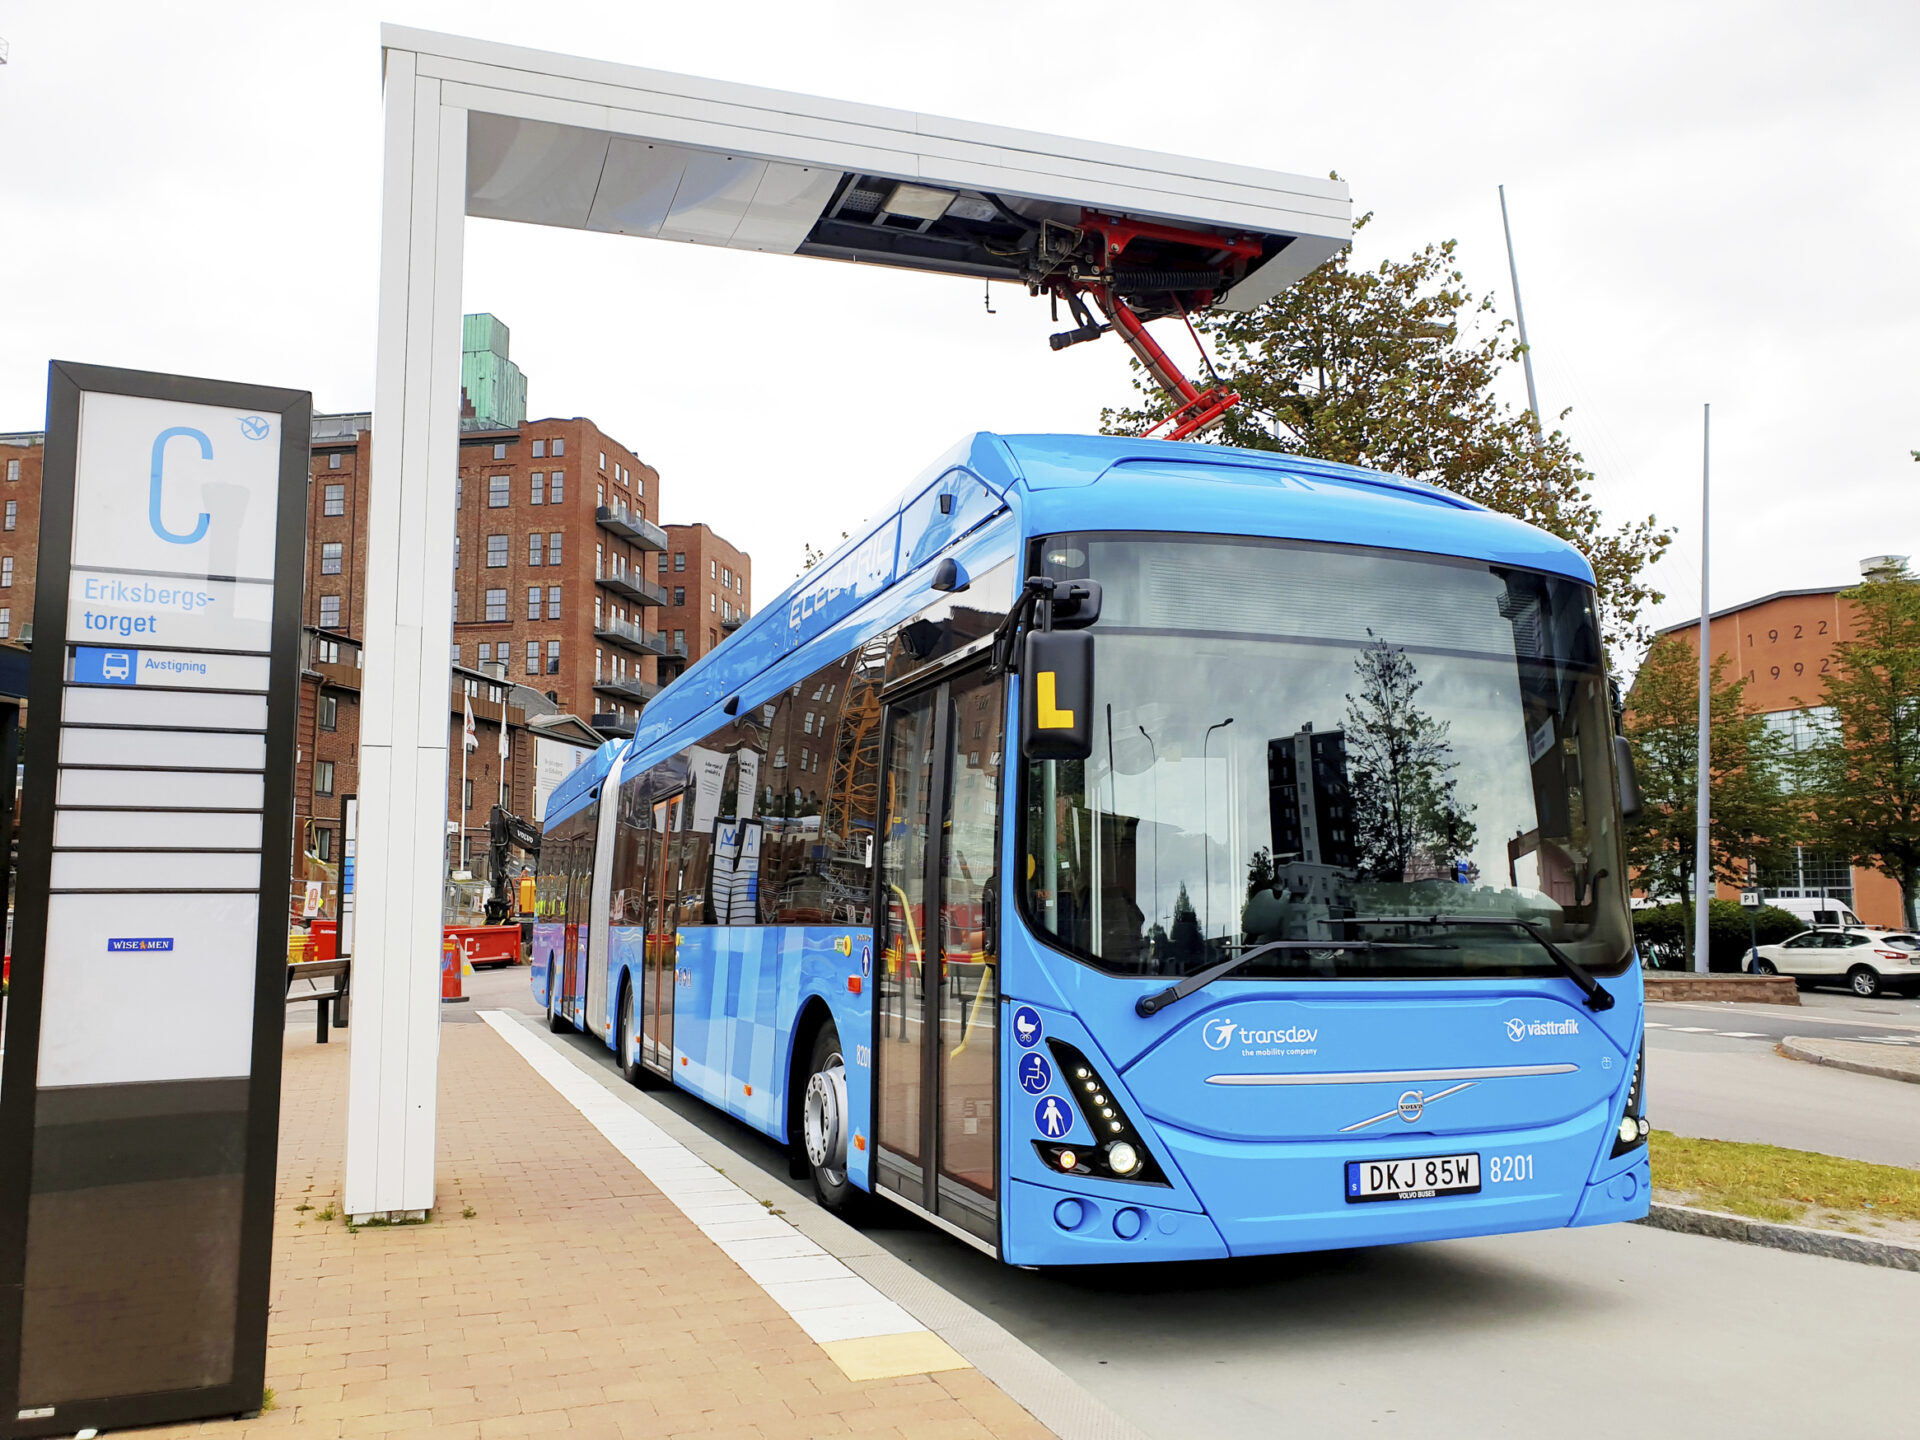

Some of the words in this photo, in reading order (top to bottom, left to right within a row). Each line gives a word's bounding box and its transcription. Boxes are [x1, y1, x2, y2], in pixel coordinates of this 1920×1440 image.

[148, 426, 213, 544] C
[85, 578, 215, 611] Eriksbergs-
[84, 611, 157, 636] torget
[145, 658, 206, 674] Avstigning
[1744, 895, 1754, 903] P1
[113, 941, 139, 949] WISE
[147, 941, 169, 949] MEN
[1239, 1025, 1318, 1044] transdev
[1527, 1019, 1579, 1036] västtrafik
[1242, 1049, 1254, 1057] the
[1256, 1048, 1285, 1056] mobility
[1286, 1047, 1317, 1056] company
[1400, 1103, 1423, 1111] VOLVO
[1370, 1163, 1416, 1191] DKJ
[1425, 1158, 1470, 1186] 85W
[1490, 1154, 1534, 1183] 8201
[1352, 1183, 1358, 1191] S
[1398, 1191, 1417, 1199] VOLVO
[1417, 1190, 1436, 1198] BUSES
